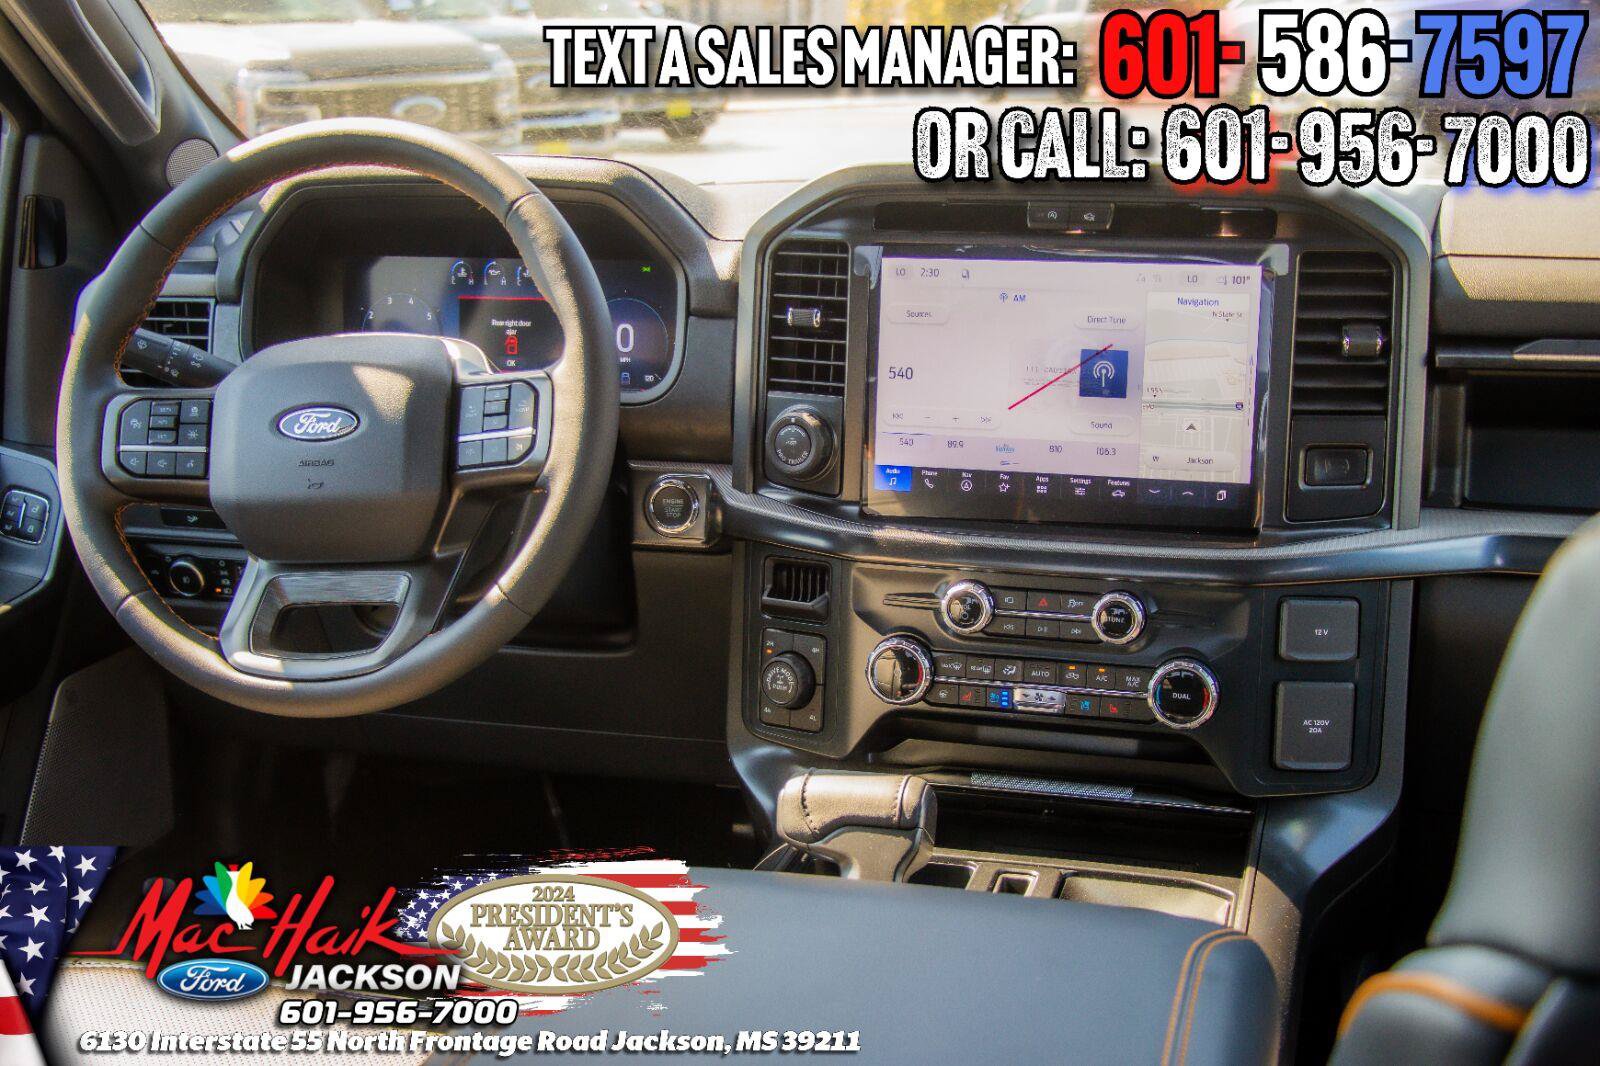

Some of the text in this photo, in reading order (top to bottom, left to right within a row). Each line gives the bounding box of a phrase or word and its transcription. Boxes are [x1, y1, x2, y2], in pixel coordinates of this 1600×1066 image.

[920, 267, 940, 277] 2:30
[386, 296, 393, 305] 3
[408, 296, 415, 305] 4
[1013, 294, 1027, 302] AM
[1177, 297, 1220, 307] Navigation
[368, 310, 374, 320] 2
[426, 312, 433, 321] 5
[905, 309, 933, 318] Sources
[1087, 315, 1127, 325] Direct Tune
[616, 322, 635, 353] 0
[888, 366, 914, 380] 540
[1090, 421, 1113, 430] Sound
[899, 437, 914, 446] 540
[947, 440, 965, 449] 89.9
[1049, 445, 1063, 454] 810
[1096, 447, 1117, 456] 106.3
[298, 459, 335, 467] AIRBAG
[1152, 455, 1160, 463] W
[1186, 456, 1214, 465] Jackson
[885, 467, 901, 475] Audio
[921, 469, 939, 477] Phone
[1000, 473, 1010, 481] Fav
[1035, 475, 1049, 484] Apps
[1069, 477, 1092, 486] Settings
[1107, 479, 1131, 487] Features
[1172, 692, 1191, 700] DUAL
